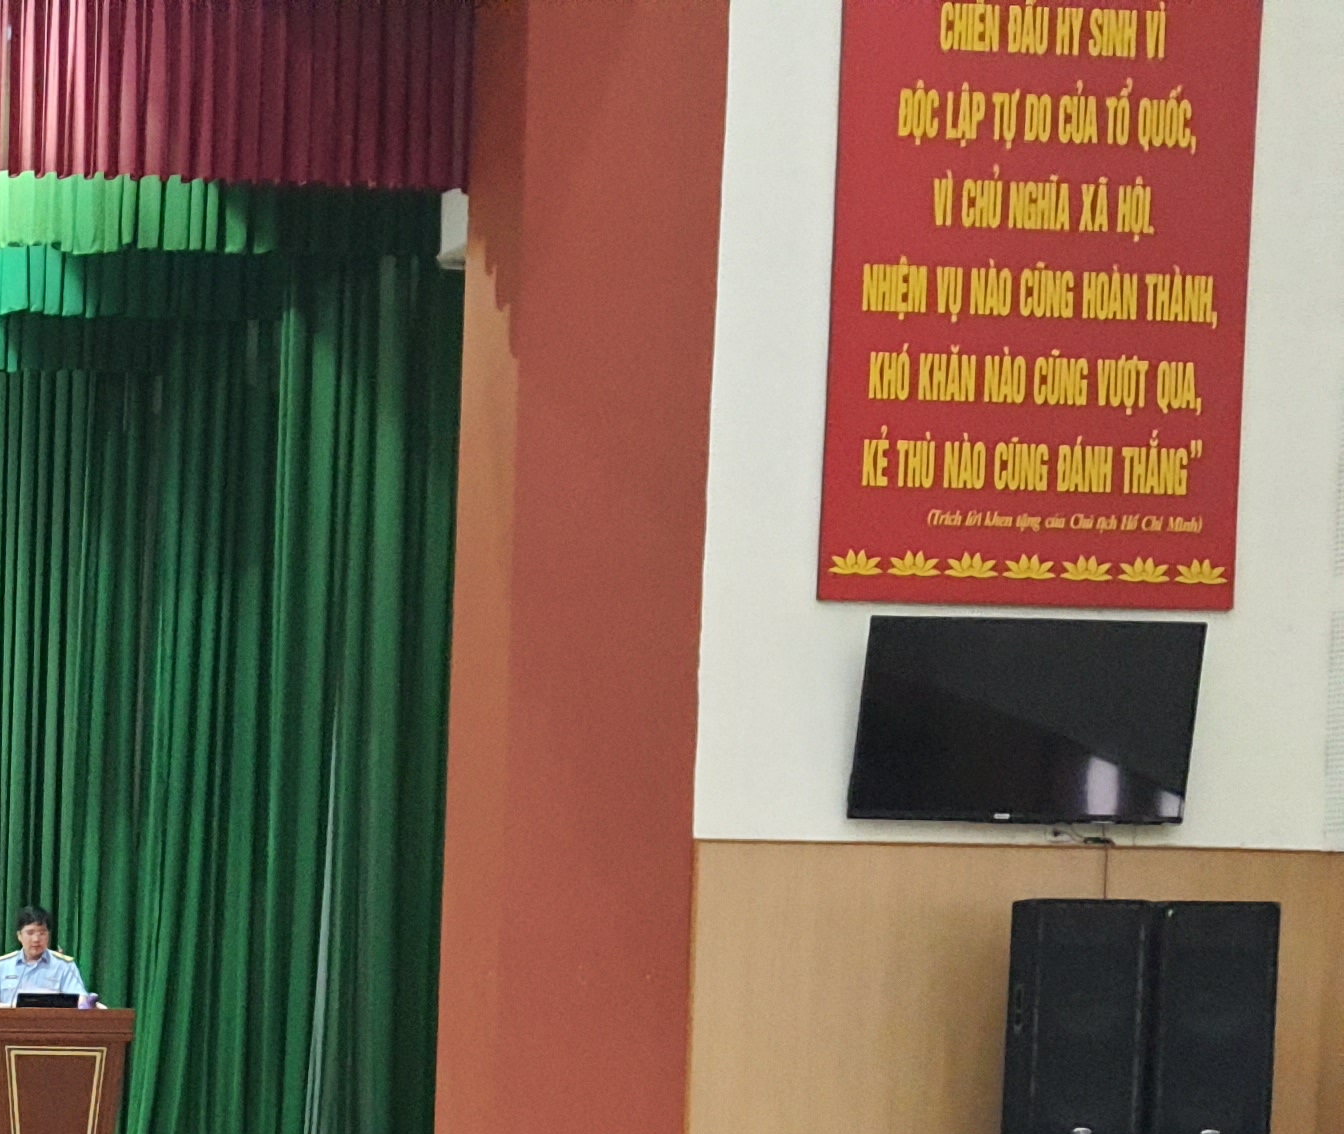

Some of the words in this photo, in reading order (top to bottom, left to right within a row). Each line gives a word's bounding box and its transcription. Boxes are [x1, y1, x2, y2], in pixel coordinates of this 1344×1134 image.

[1056, 7, 1084, 57] HY
[1089, 8, 1138, 60] SINH
[1146, 1, 1166, 60] VÌ
[898, 79, 940, 146] ĐỘC
[946, 82, 986, 148] LẬP
[992, 88, 1021, 150] TỰ
[1024, 93, 1052, 143] DO
[1058, 79, 1098, 144] CỦA
[1106, 77, 1133, 145] TỔ
[1138, 84, 1197, 155] QUỐC,
[934, 169, 954, 227] VÌ
[962, 163, 1003, 228] CHỦ
[1009, 174, 1070, 231] NGHĨA
[1079, 176, 1109, 232] XÃ
[863, 255, 928, 320] NHIỆM
[937, 266, 964, 323] VỤ
[970, 258, 1013, 317] NÀO
[1020, 262, 1074, 319] CŨNG
[1083, 264, 1138, 321] HOÀN
[1146, 264, 1218, 328] THÀNH,
[869, 342, 911, 400] KHÓ
[918, 346, 977, 402] KHĂN
[984, 346, 1026, 404] NÀO
[1034, 349, 1089, 406] CŨNG
[1098, 355, 1150, 415] VƯỢT
[1157, 362, 1202, 414] QUA,
[862, 425, 889, 487] KẺ
[897, 432, 936, 489] THÙ
[943, 434, 987, 490] NÀO
[994, 437, 1049, 492] CŨNG
[1057, 436, 1114, 493] ĐÁNH
